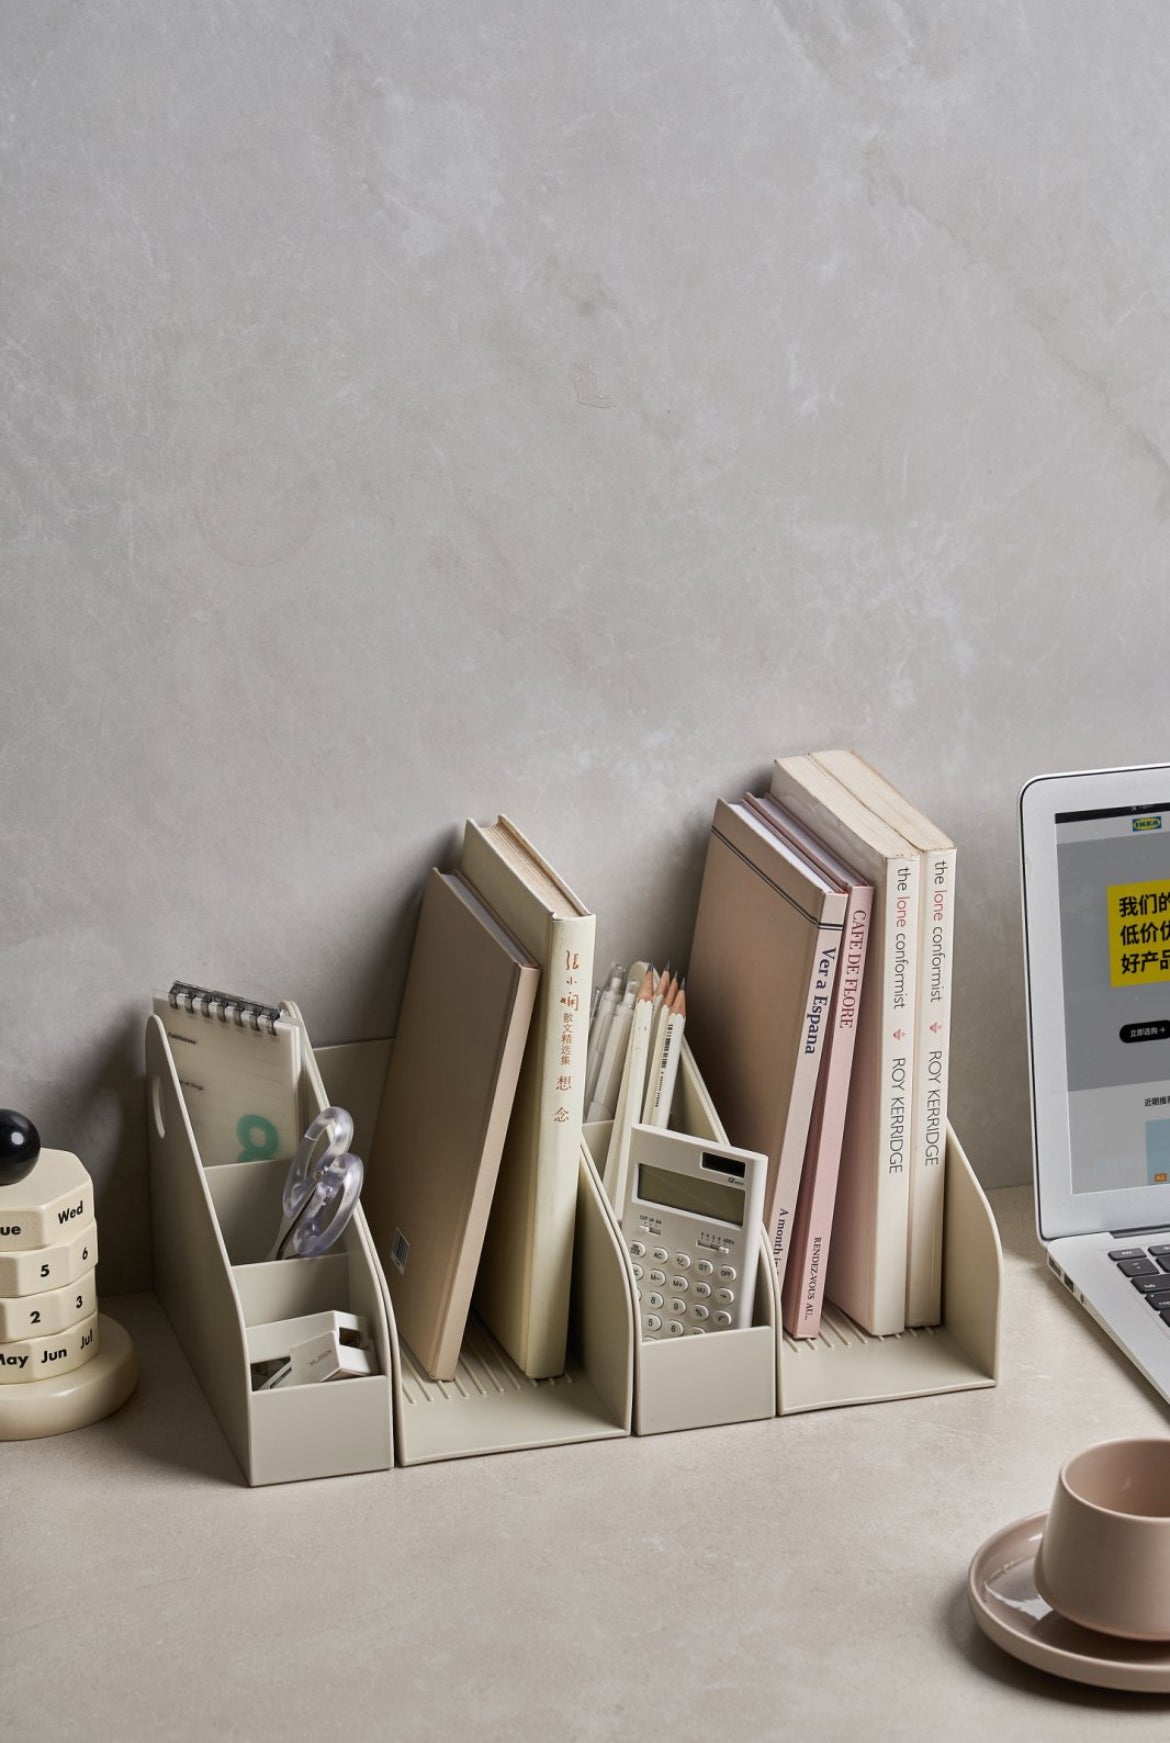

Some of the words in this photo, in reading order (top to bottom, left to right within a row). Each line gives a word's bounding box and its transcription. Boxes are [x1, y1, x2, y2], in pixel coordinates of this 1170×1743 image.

[897, 867, 912, 892] the
[934, 860, 948, 885] the
[896, 896, 911, 928] lone
[932, 890, 947, 921] lone
[850, 909, 867, 950] CAFE
[818, 947, 837, 975] Ver
[846, 953, 862, 974] DE
[893, 932, 909, 1010] conformist
[930, 926, 946, 1003] conformist
[814, 979, 827, 989] a
[839, 978, 859, 1029] FLORE
[804, 994, 829, 1055] Espana
[891, 1058, 906, 1091] ROY
[927, 1050, 943, 1084] ROY
[888, 1096, 905, 1174] KERRIDGE
[924, 1089, 941, 1166] KERRIDGE
[58, 1201, 84, 1224] Wed
[779, 1208, 789, 1217] A
[773, 1219, 786, 1255] month
[82, 1247, 88, 1260] 6
[40, 1264, 50, 1277] 5
[76, 1296, 83, 1309] 3
[30, 1311, 41, 1324] 2
[80, 1328, 93, 1350] Jul
[41, 1348, 68, 1364] Jun
